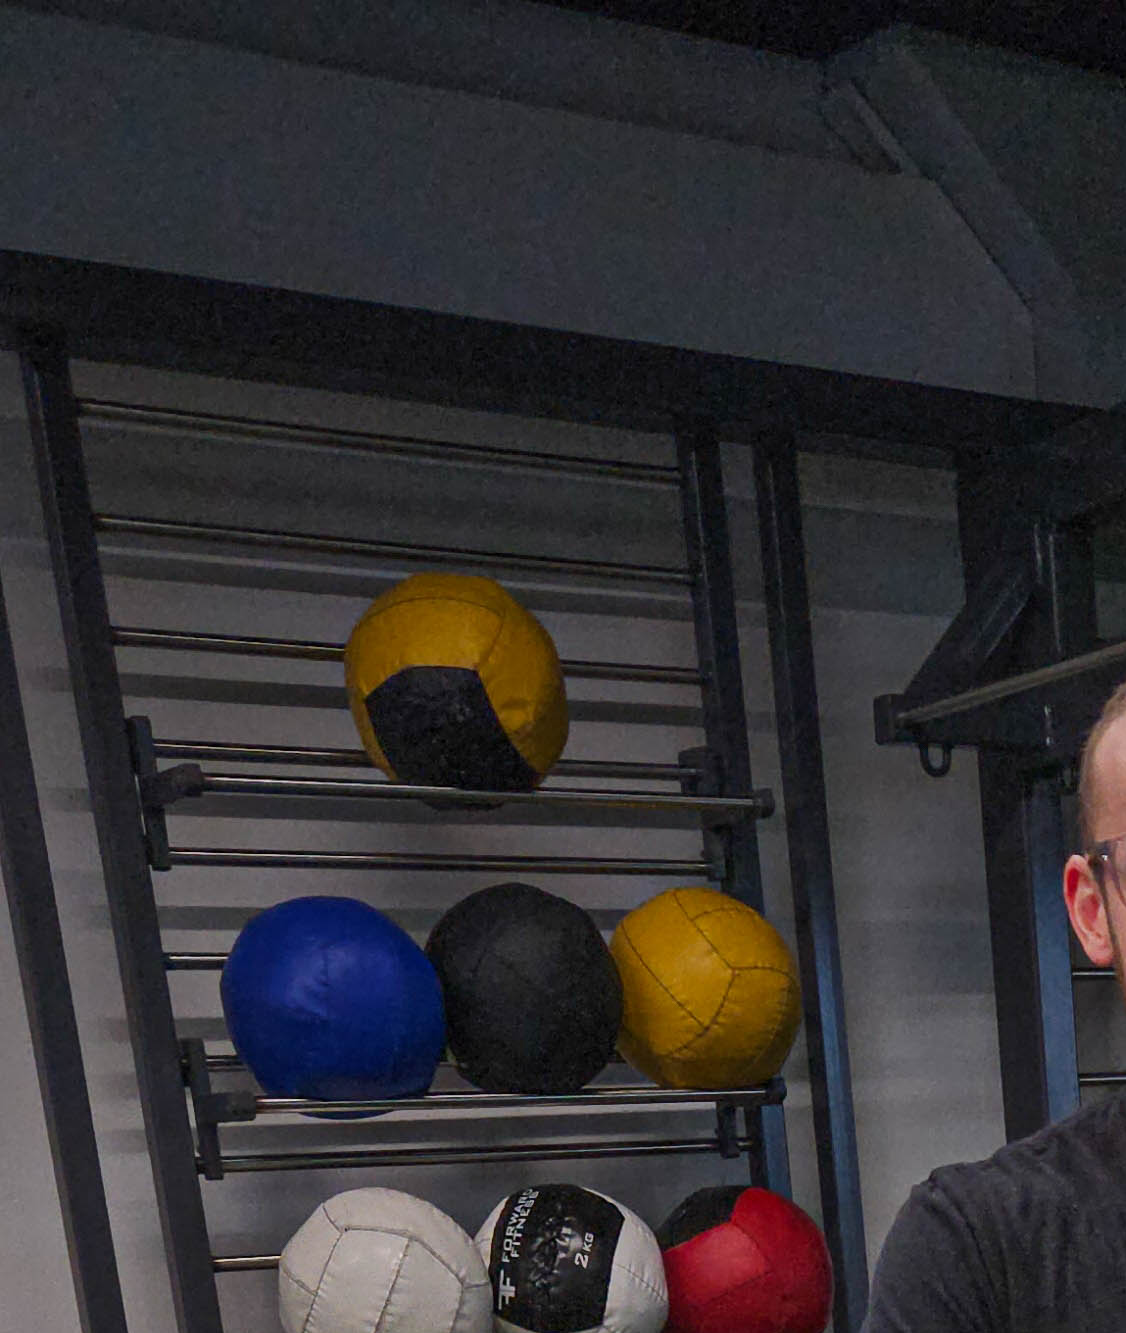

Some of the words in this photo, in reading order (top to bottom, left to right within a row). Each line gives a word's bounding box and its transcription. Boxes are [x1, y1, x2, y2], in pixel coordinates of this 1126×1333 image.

[502, 1188, 533, 1263] FORWARD
[511, 1190, 540, 1259] FITNESS
[574, 1253, 589, 1270] 2
[583, 1232, 595, 1252] KG
